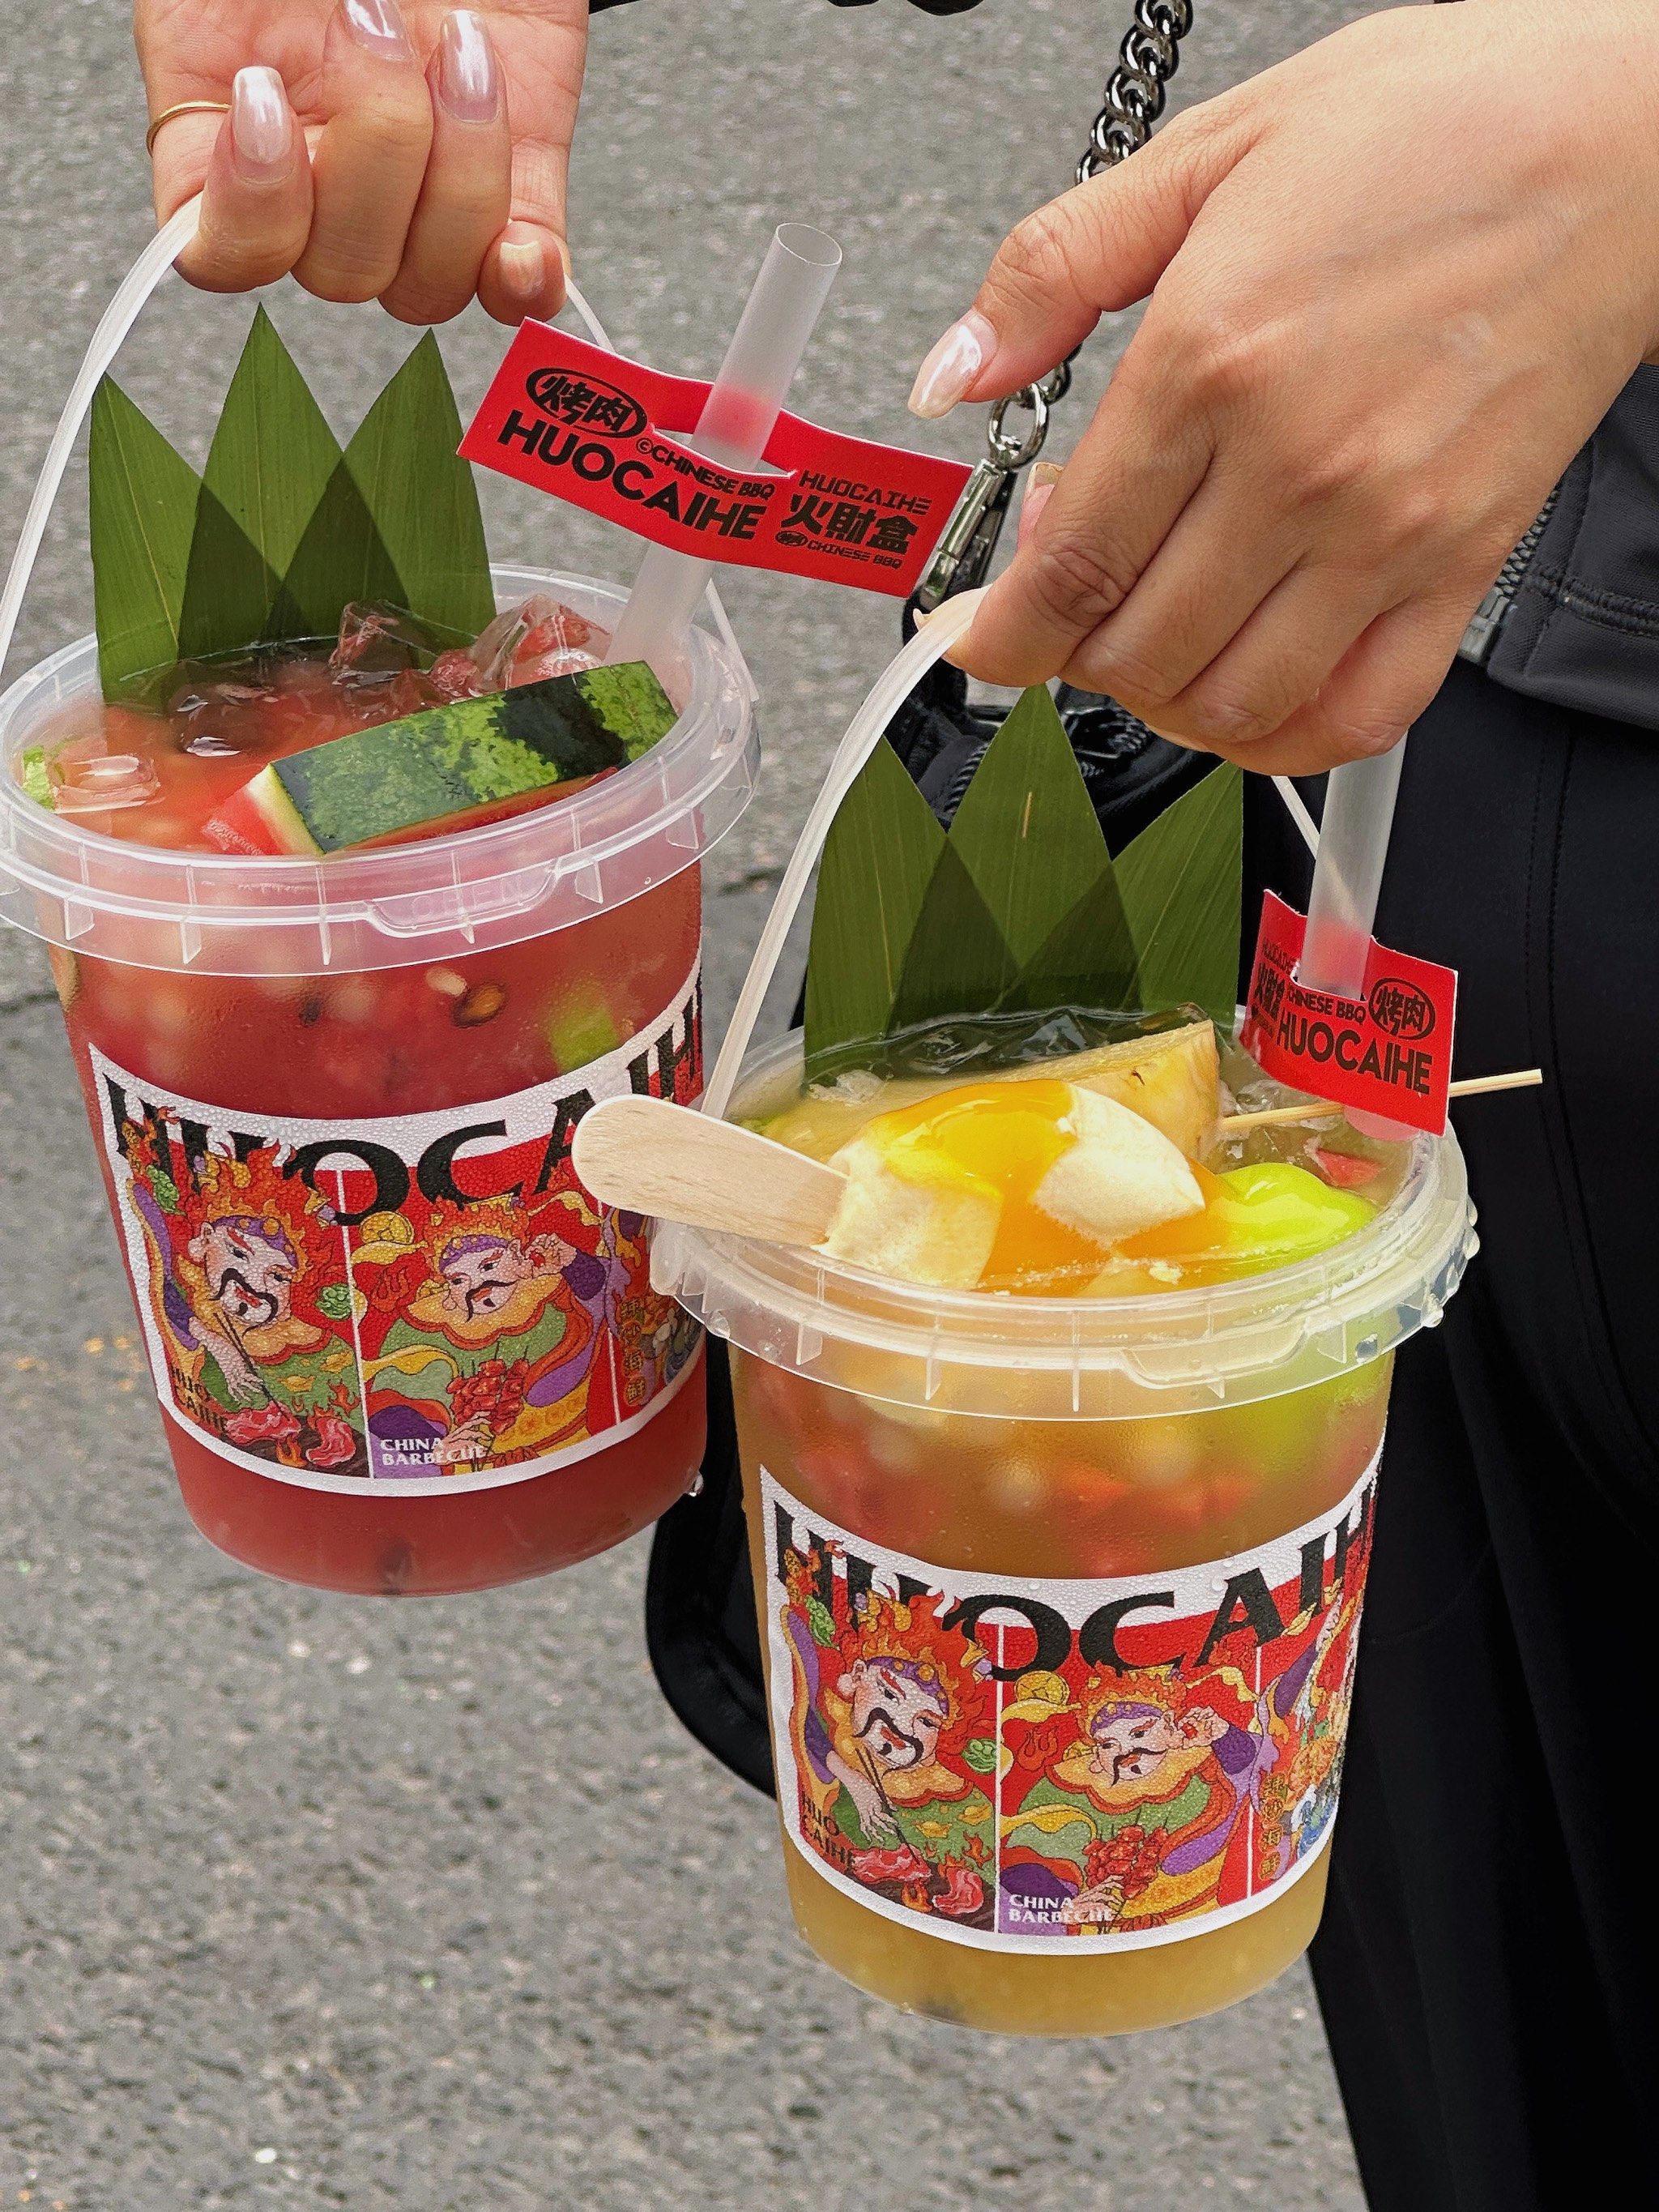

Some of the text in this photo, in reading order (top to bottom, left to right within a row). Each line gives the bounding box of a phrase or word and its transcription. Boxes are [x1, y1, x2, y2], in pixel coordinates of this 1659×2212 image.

[536, 375, 634, 433] 烤肉
[497, 408, 768, 540] HUOCAIHE
[738, 481, 776, 502] BBQ
[798, 469, 932, 516] HUOCAIHE
[780, 493, 919, 556] 火財盒
[807, 539, 872, 562] CHINESE
[1337, 1000, 1367, 1026] BBQ
[1375, 984, 1429, 1037] 烤肉
[1276, 1006, 1434, 1095] HUOCAIHE
[380, 1437, 444, 1452] CHINA
[1009, 1894, 1073, 1910] CHINA
